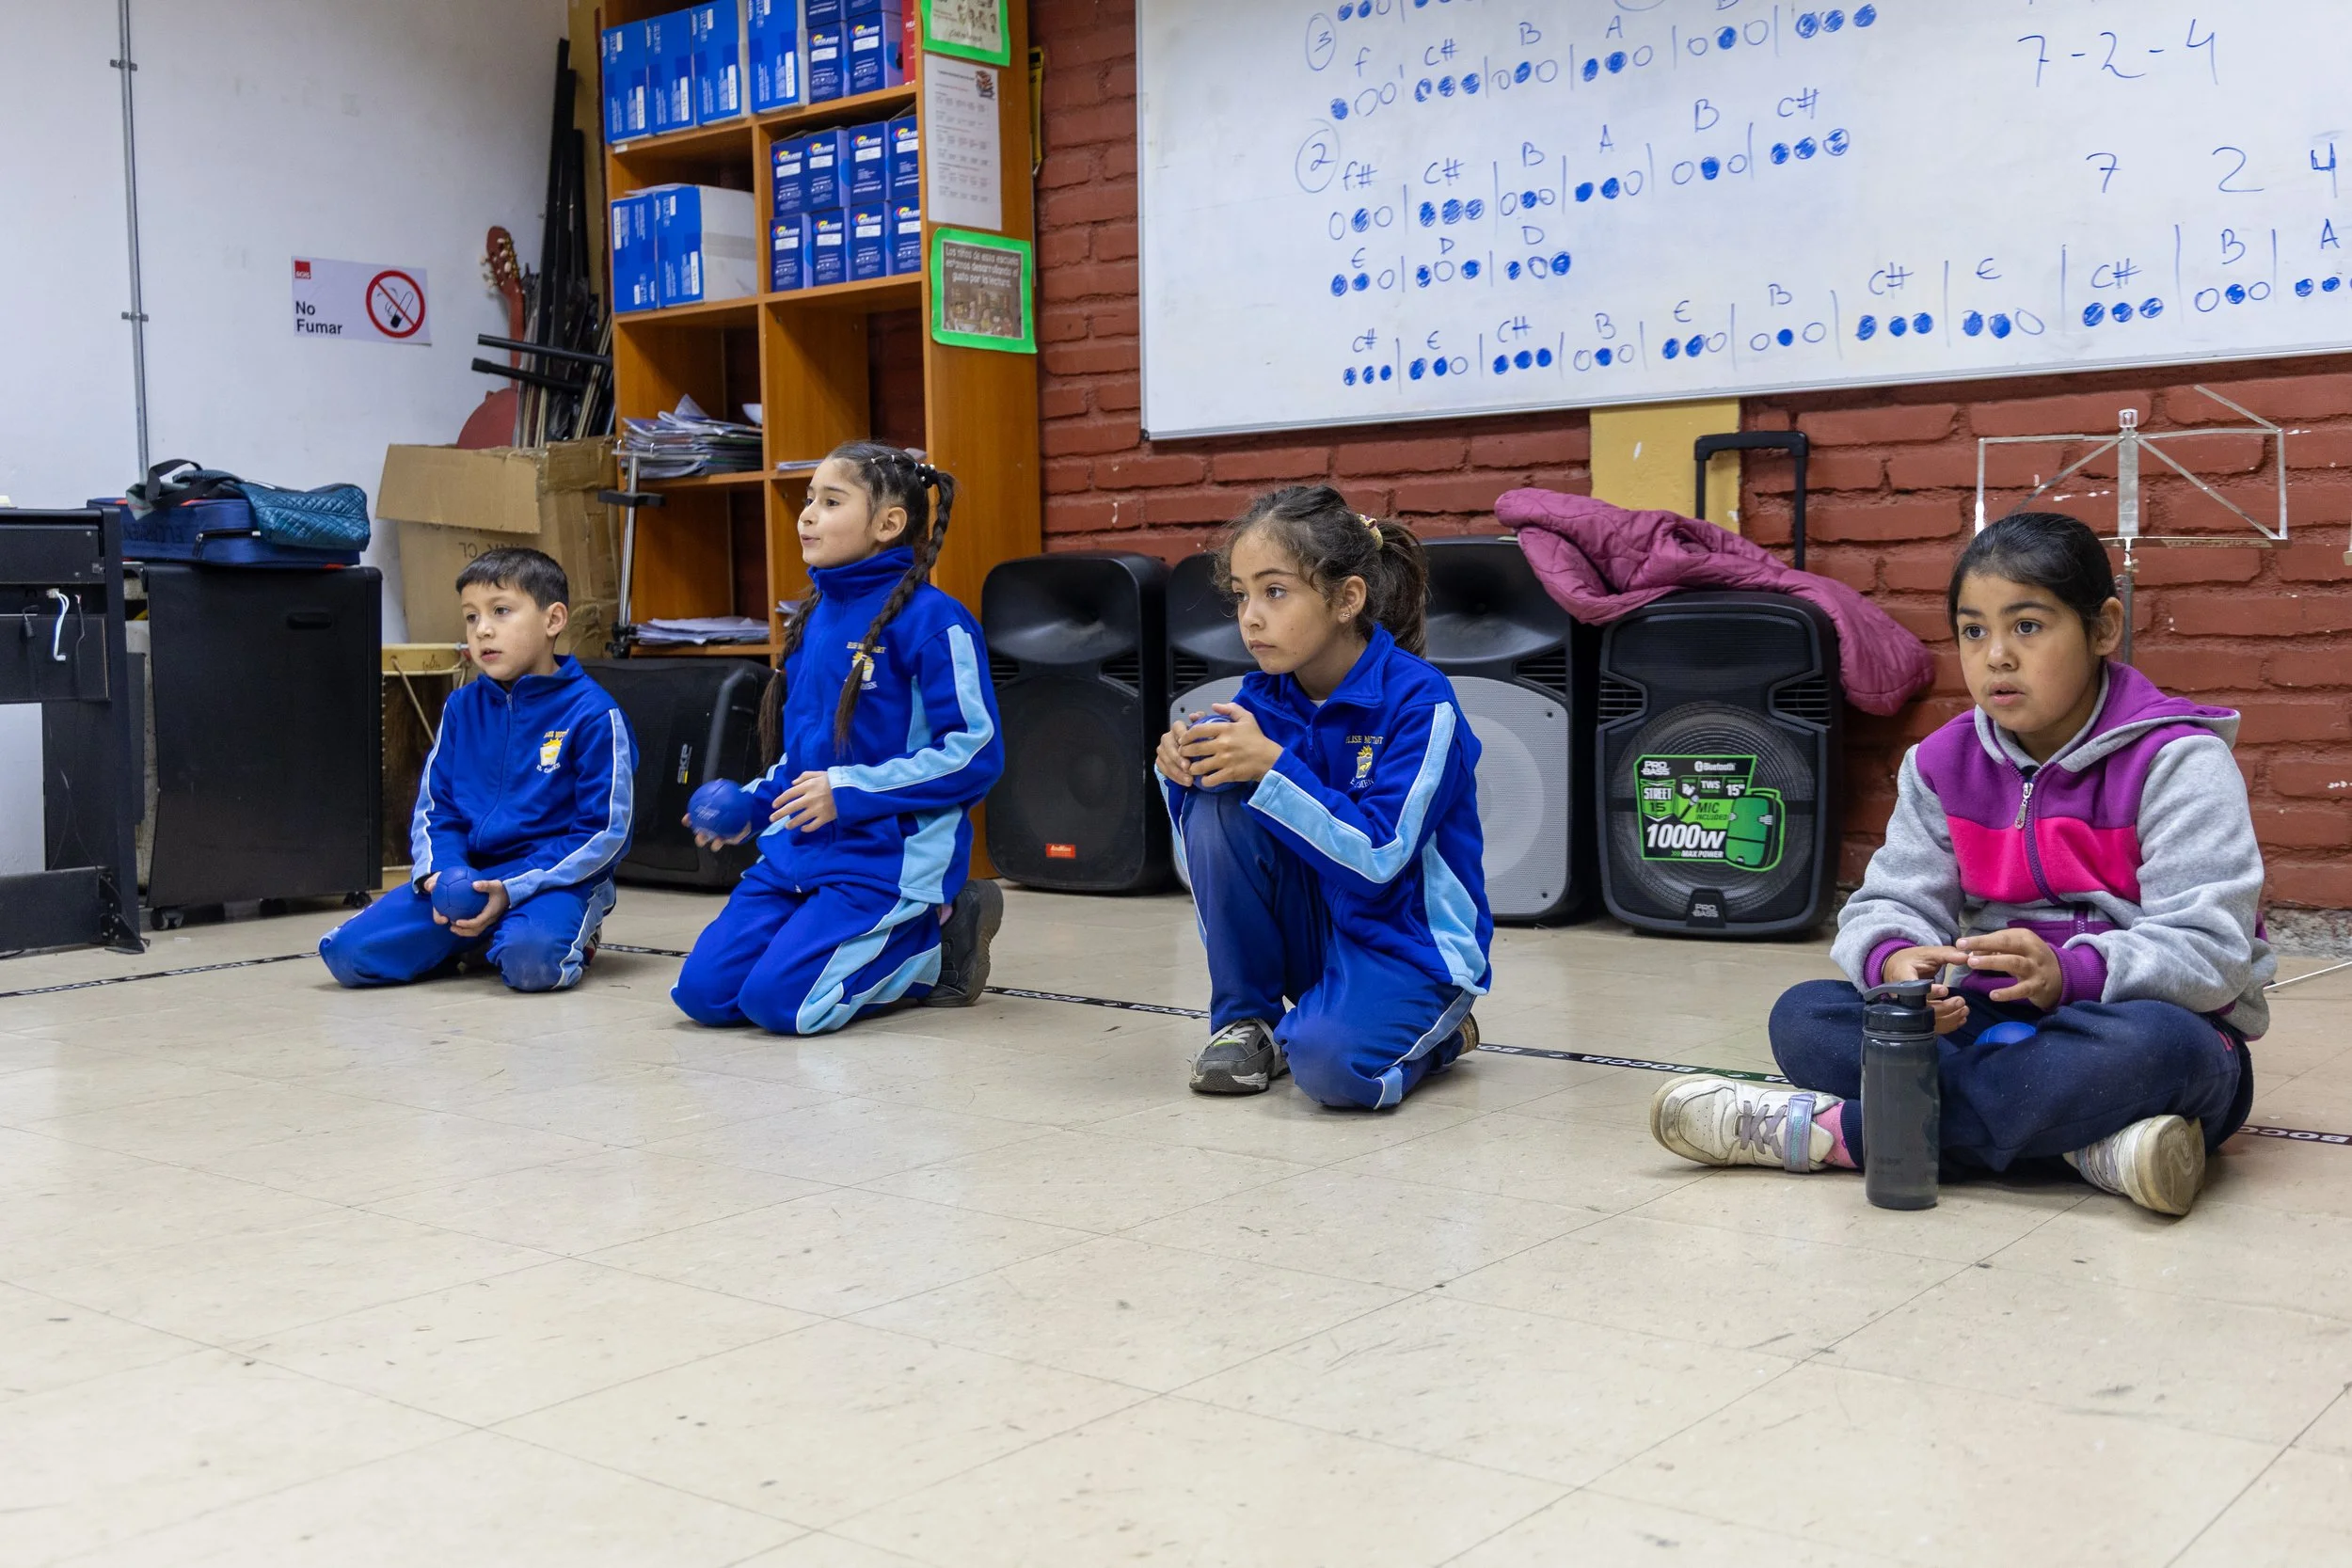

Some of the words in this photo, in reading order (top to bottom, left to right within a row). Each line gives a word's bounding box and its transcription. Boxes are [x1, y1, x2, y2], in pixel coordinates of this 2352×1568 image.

[1423, 38, 1459, 66] C#
[1518, 22, 1542, 45] B
[1605, 15, 1624, 39] A
[1423, 157, 1465, 186] C#
[1521, 141, 1546, 166] B
[1599, 124, 1618, 153] A
[1692, 98, 1721, 130] B
[1776, 87, 1820, 119] C#
[2086, 151, 2122, 193] 7
[2212, 146, 2265, 194] 2
[2310, 142, 2339, 198] 4
[1439, 237, 1454, 255] D
[1521, 226, 1546, 245] D
[1352, 327, 1377, 354] C#
[1496, 316, 1532, 342] C#
[1595, 312, 1616, 339] B
[1768, 284, 1793, 308] B
[1868, 261, 1914, 298] C#
[2090, 258, 2143, 290] C#
[2219, 228, 2247, 265] B
[2319, 218, 2341, 250] A
[295, 300, 316, 315] No
[296, 318, 342, 335] Fumar
[1641, 768, 1671, 776] BASS
[1704, 762, 1736, 771] Bluetooth
[1700, 780, 1721, 789] TWS
[1643, 787, 1672, 800] STREET
[1649, 802, 1666, 812] 15
[1696, 802, 1720, 814] MIC
[1698, 850, 1724, 859] POWER
[1694, 903, 1717, 911] PRO
[1581, 1055, 1698, 1072] BOCCIA
[2238, 1126, 2350, 1144] BOCC
